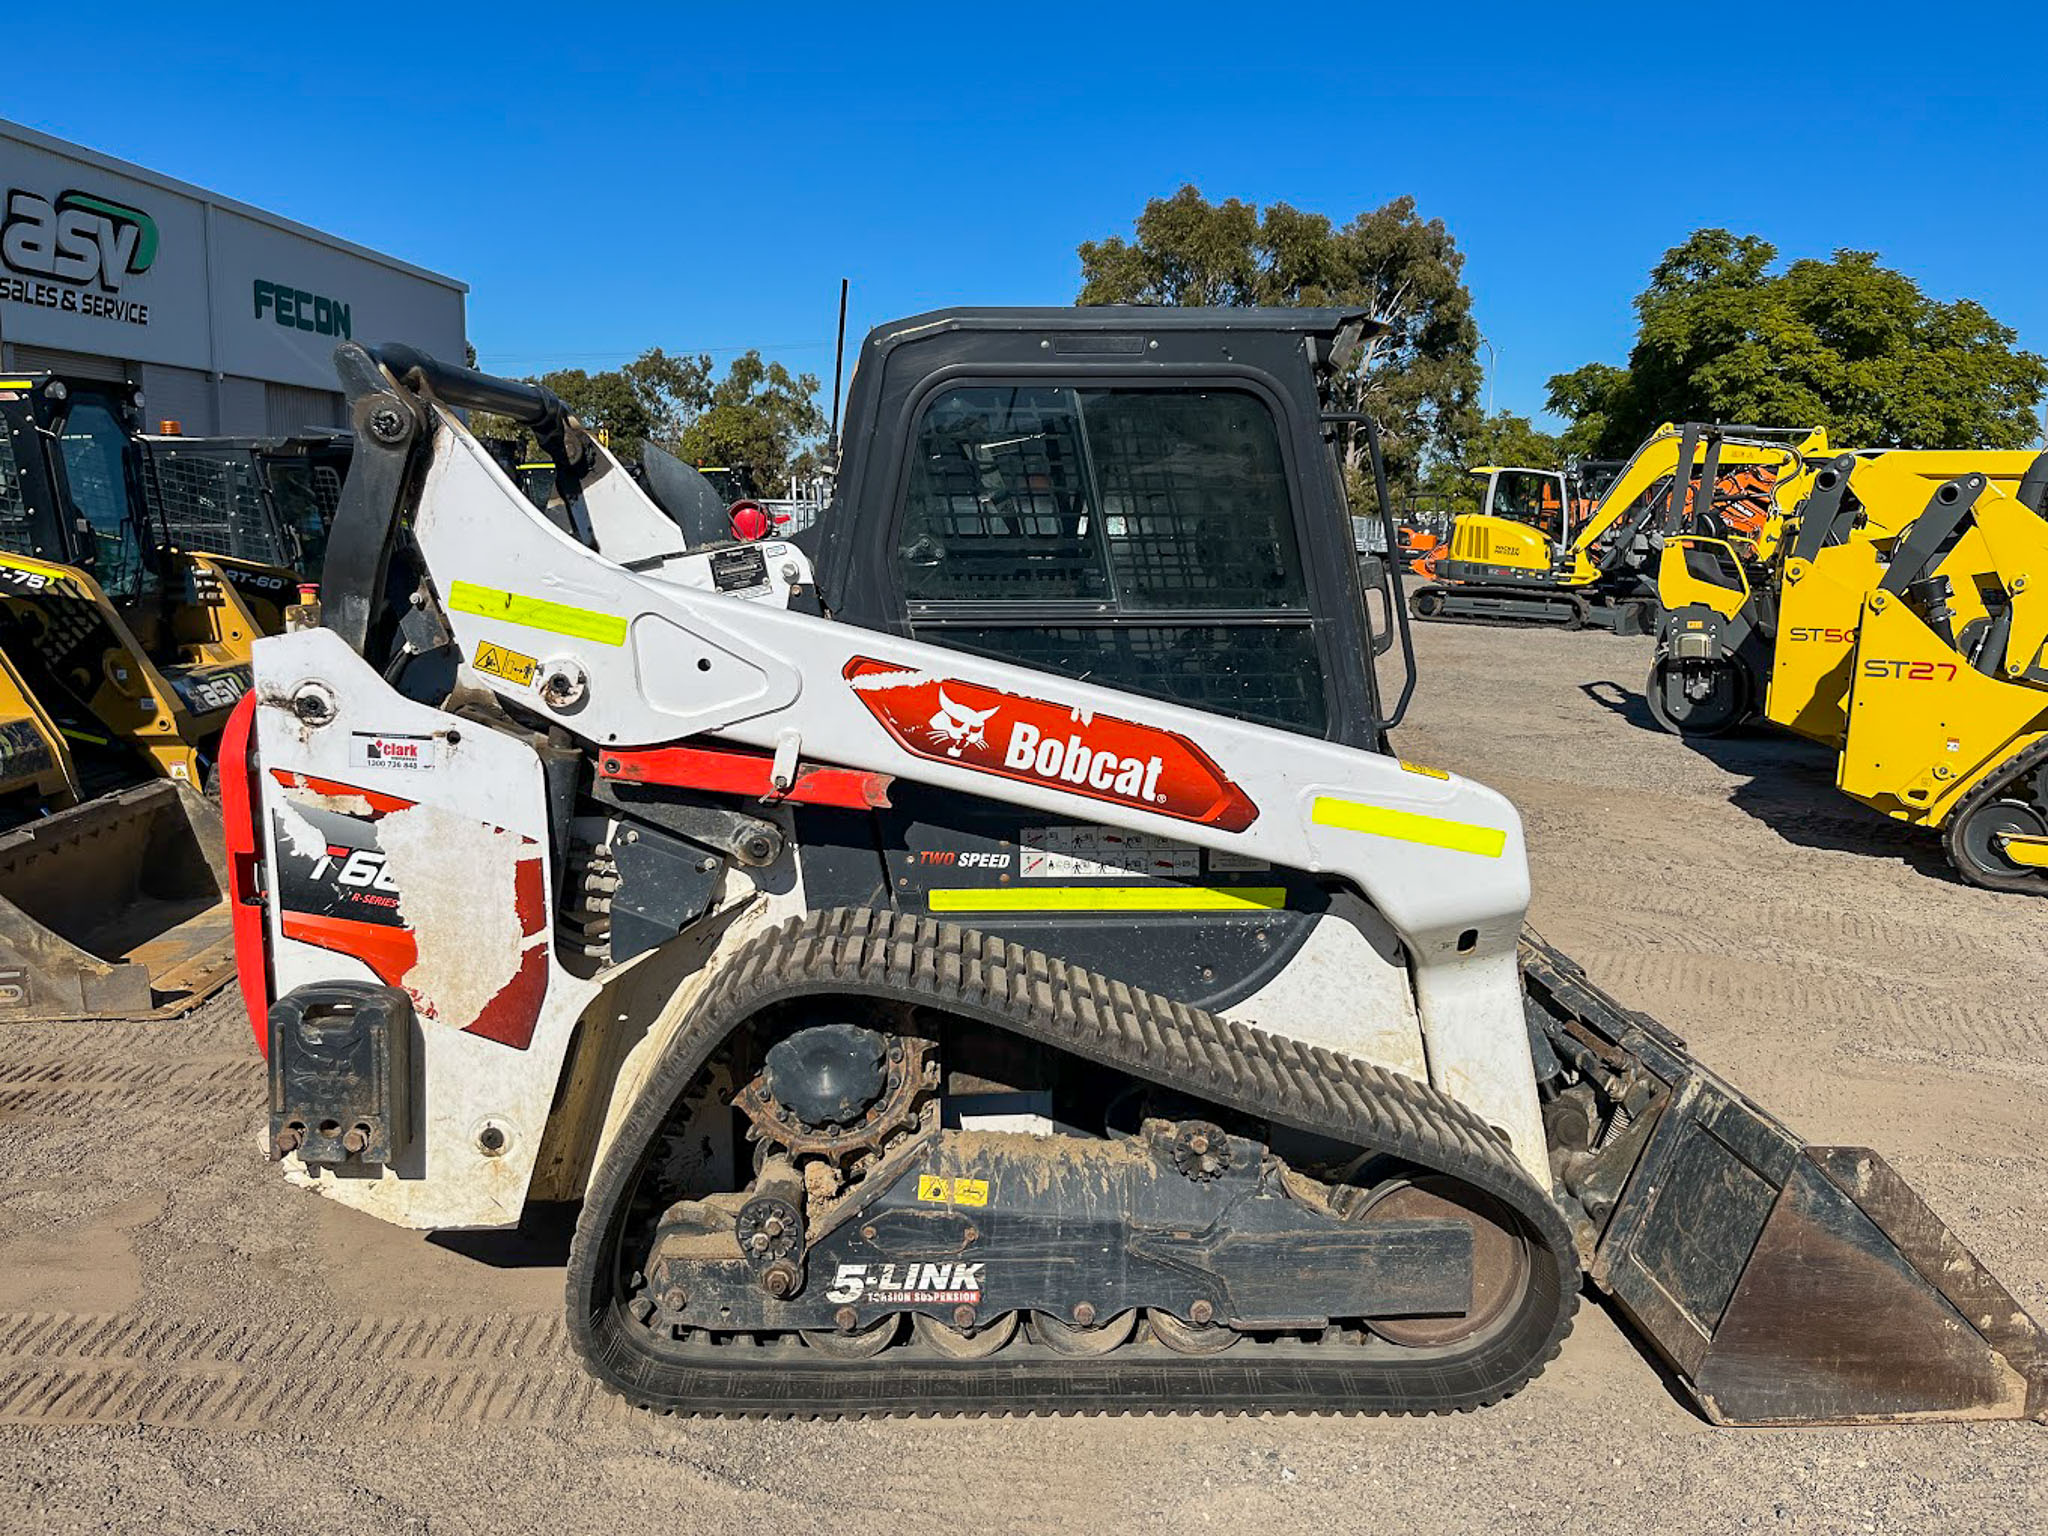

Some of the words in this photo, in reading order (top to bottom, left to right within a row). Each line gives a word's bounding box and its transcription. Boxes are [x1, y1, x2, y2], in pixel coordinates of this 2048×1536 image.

[61, 290, 77, 312] &
[82, 294, 149, 325] SERVICE
[254, 279, 352, 340] FECON
[226, 569, 282, 589] RT-60
[1864, 660, 1957, 681] ST27
[383, 743, 418, 757] clark
[920, 851, 955, 866] TWO
[957, 852, 1011, 868] SPEED
[352, 892, 399, 908] R-SERIES
[826, 1263, 985, 1304] 5-LINK
[914, 1292, 977, 1303] SUSPENSION
